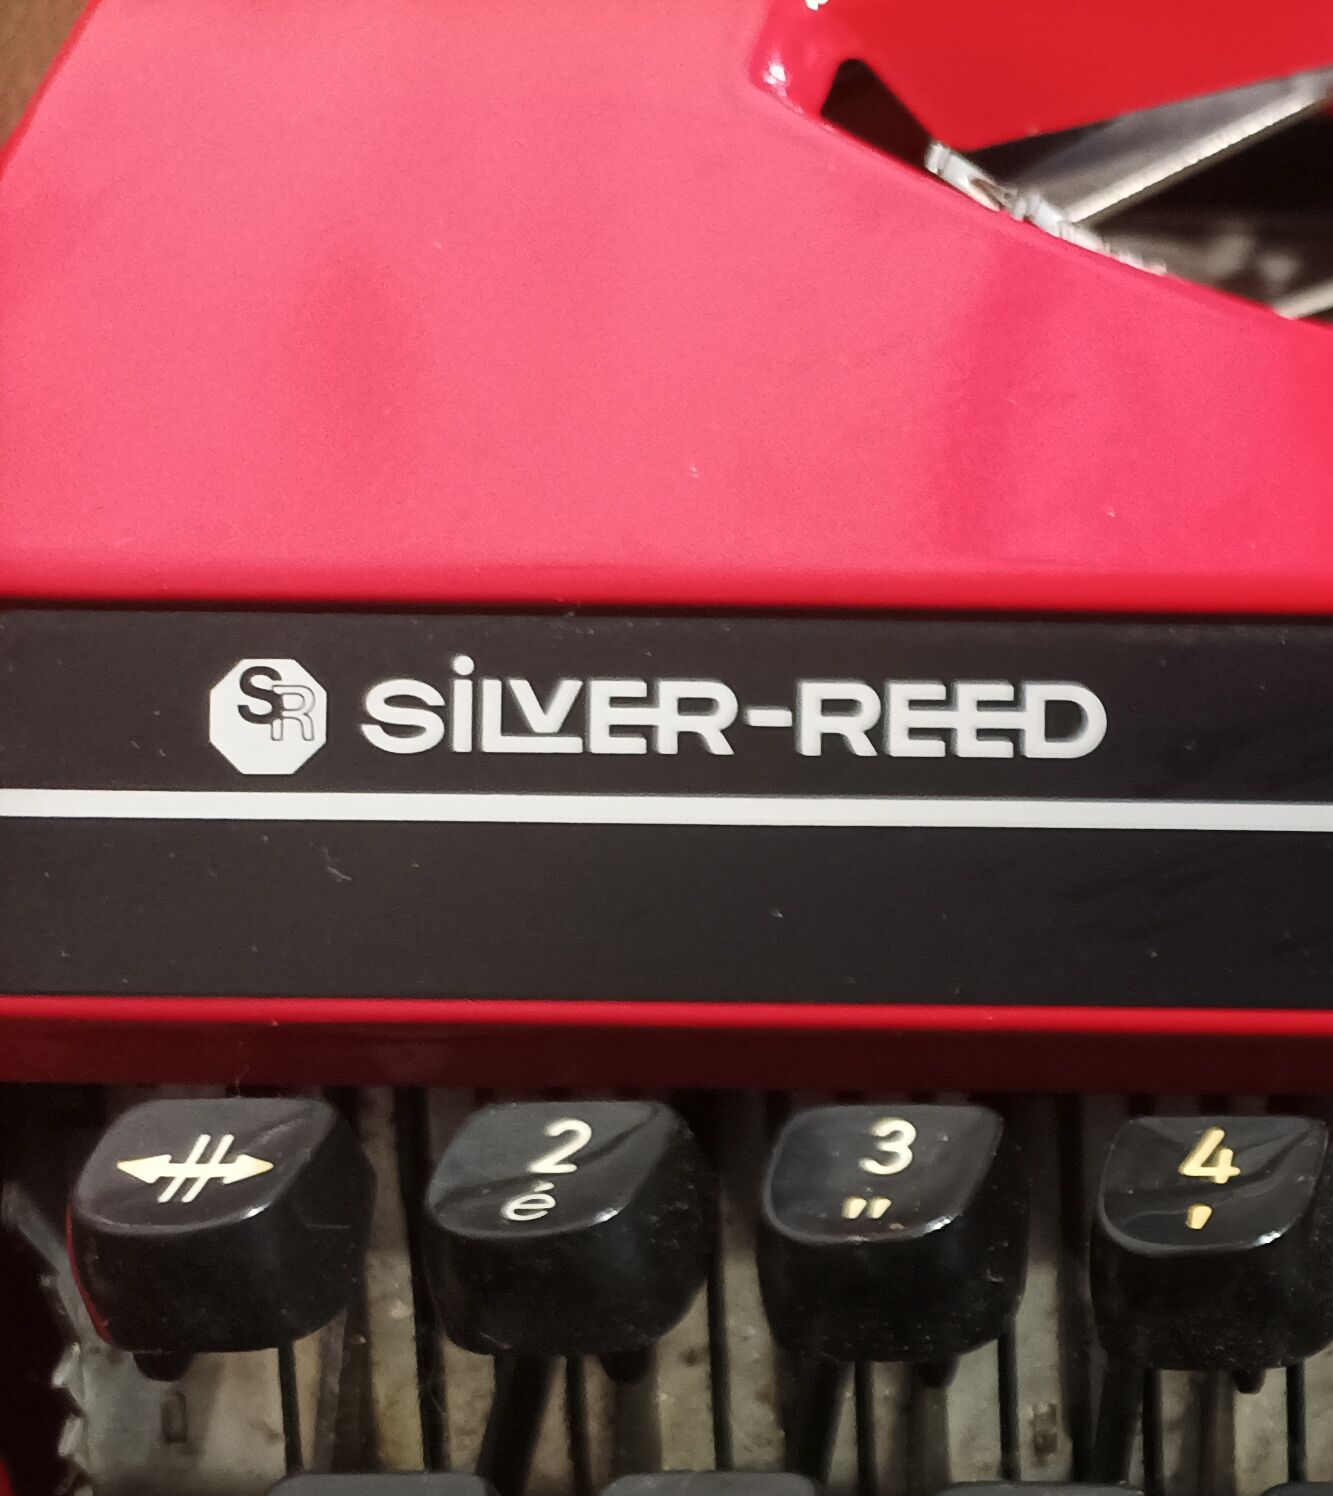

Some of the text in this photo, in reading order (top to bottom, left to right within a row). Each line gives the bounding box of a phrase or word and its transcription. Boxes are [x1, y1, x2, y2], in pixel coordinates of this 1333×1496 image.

[527, 1119, 592, 1174] 2
[860, 1118, 917, 1175] 3
[1179, 1128, 1241, 1184] 4
[501, 1180, 556, 1221] é
